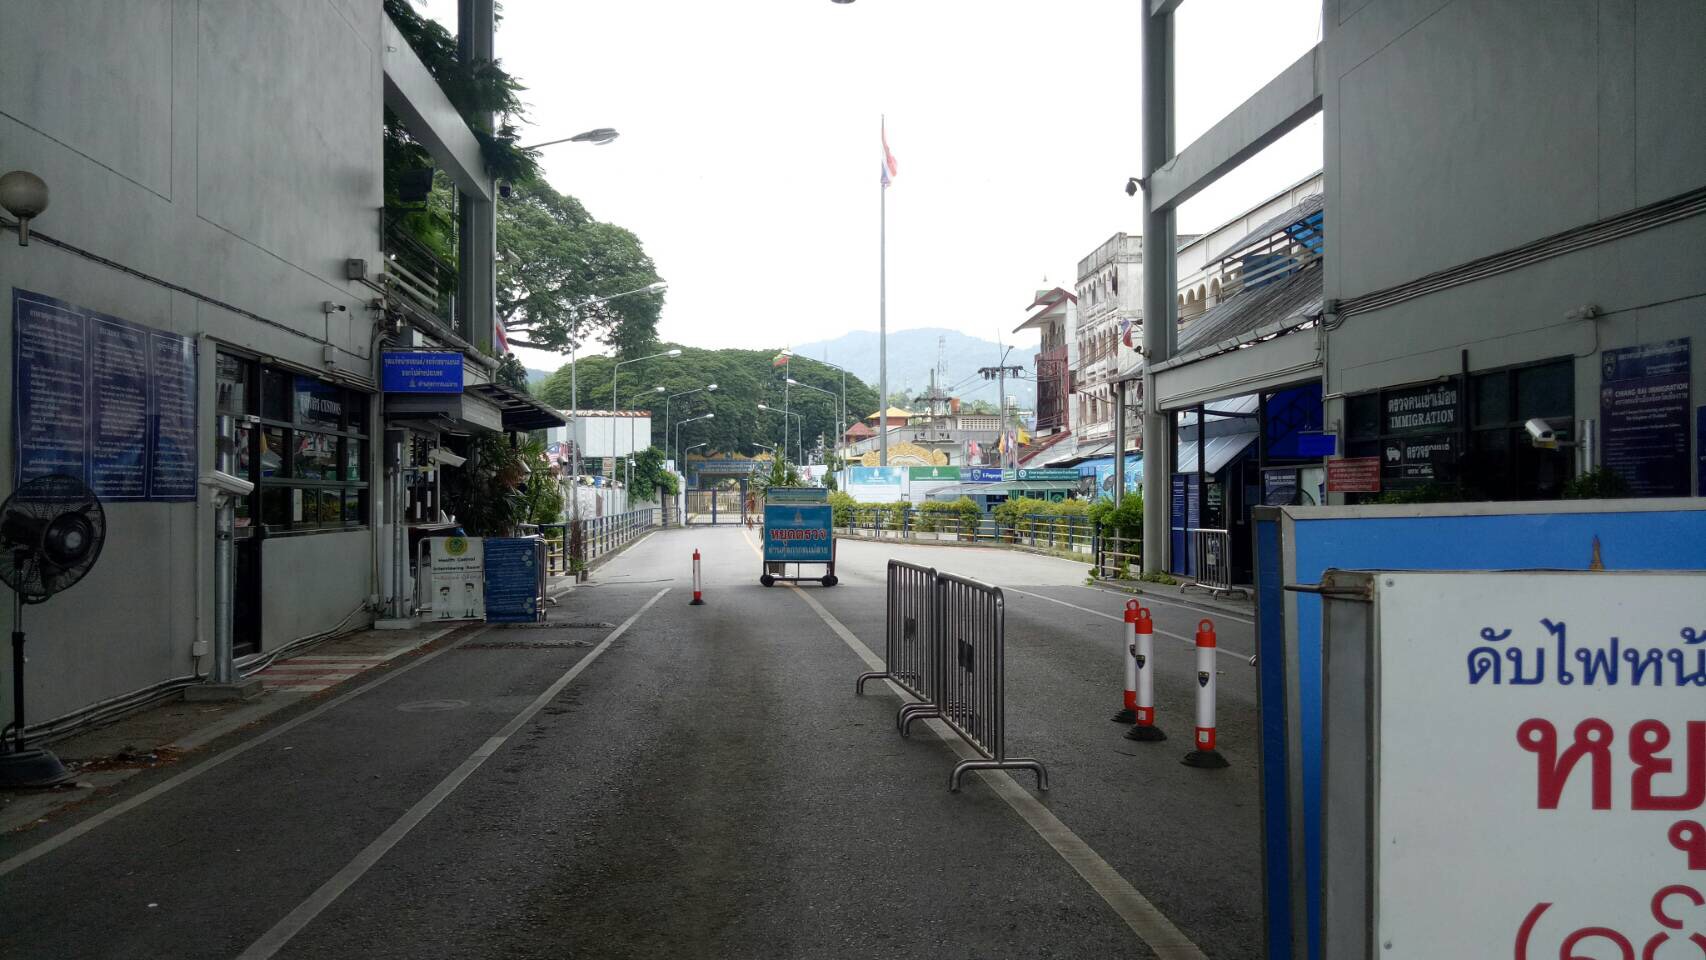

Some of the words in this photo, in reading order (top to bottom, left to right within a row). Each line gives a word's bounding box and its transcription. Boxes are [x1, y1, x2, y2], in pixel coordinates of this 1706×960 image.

[1388, 386, 1457, 413] ตรวจคนเข้าเมือง
[1391, 409, 1455, 429] IMMIGRATION
[769, 528, 827, 546] หยุดตรวจ
